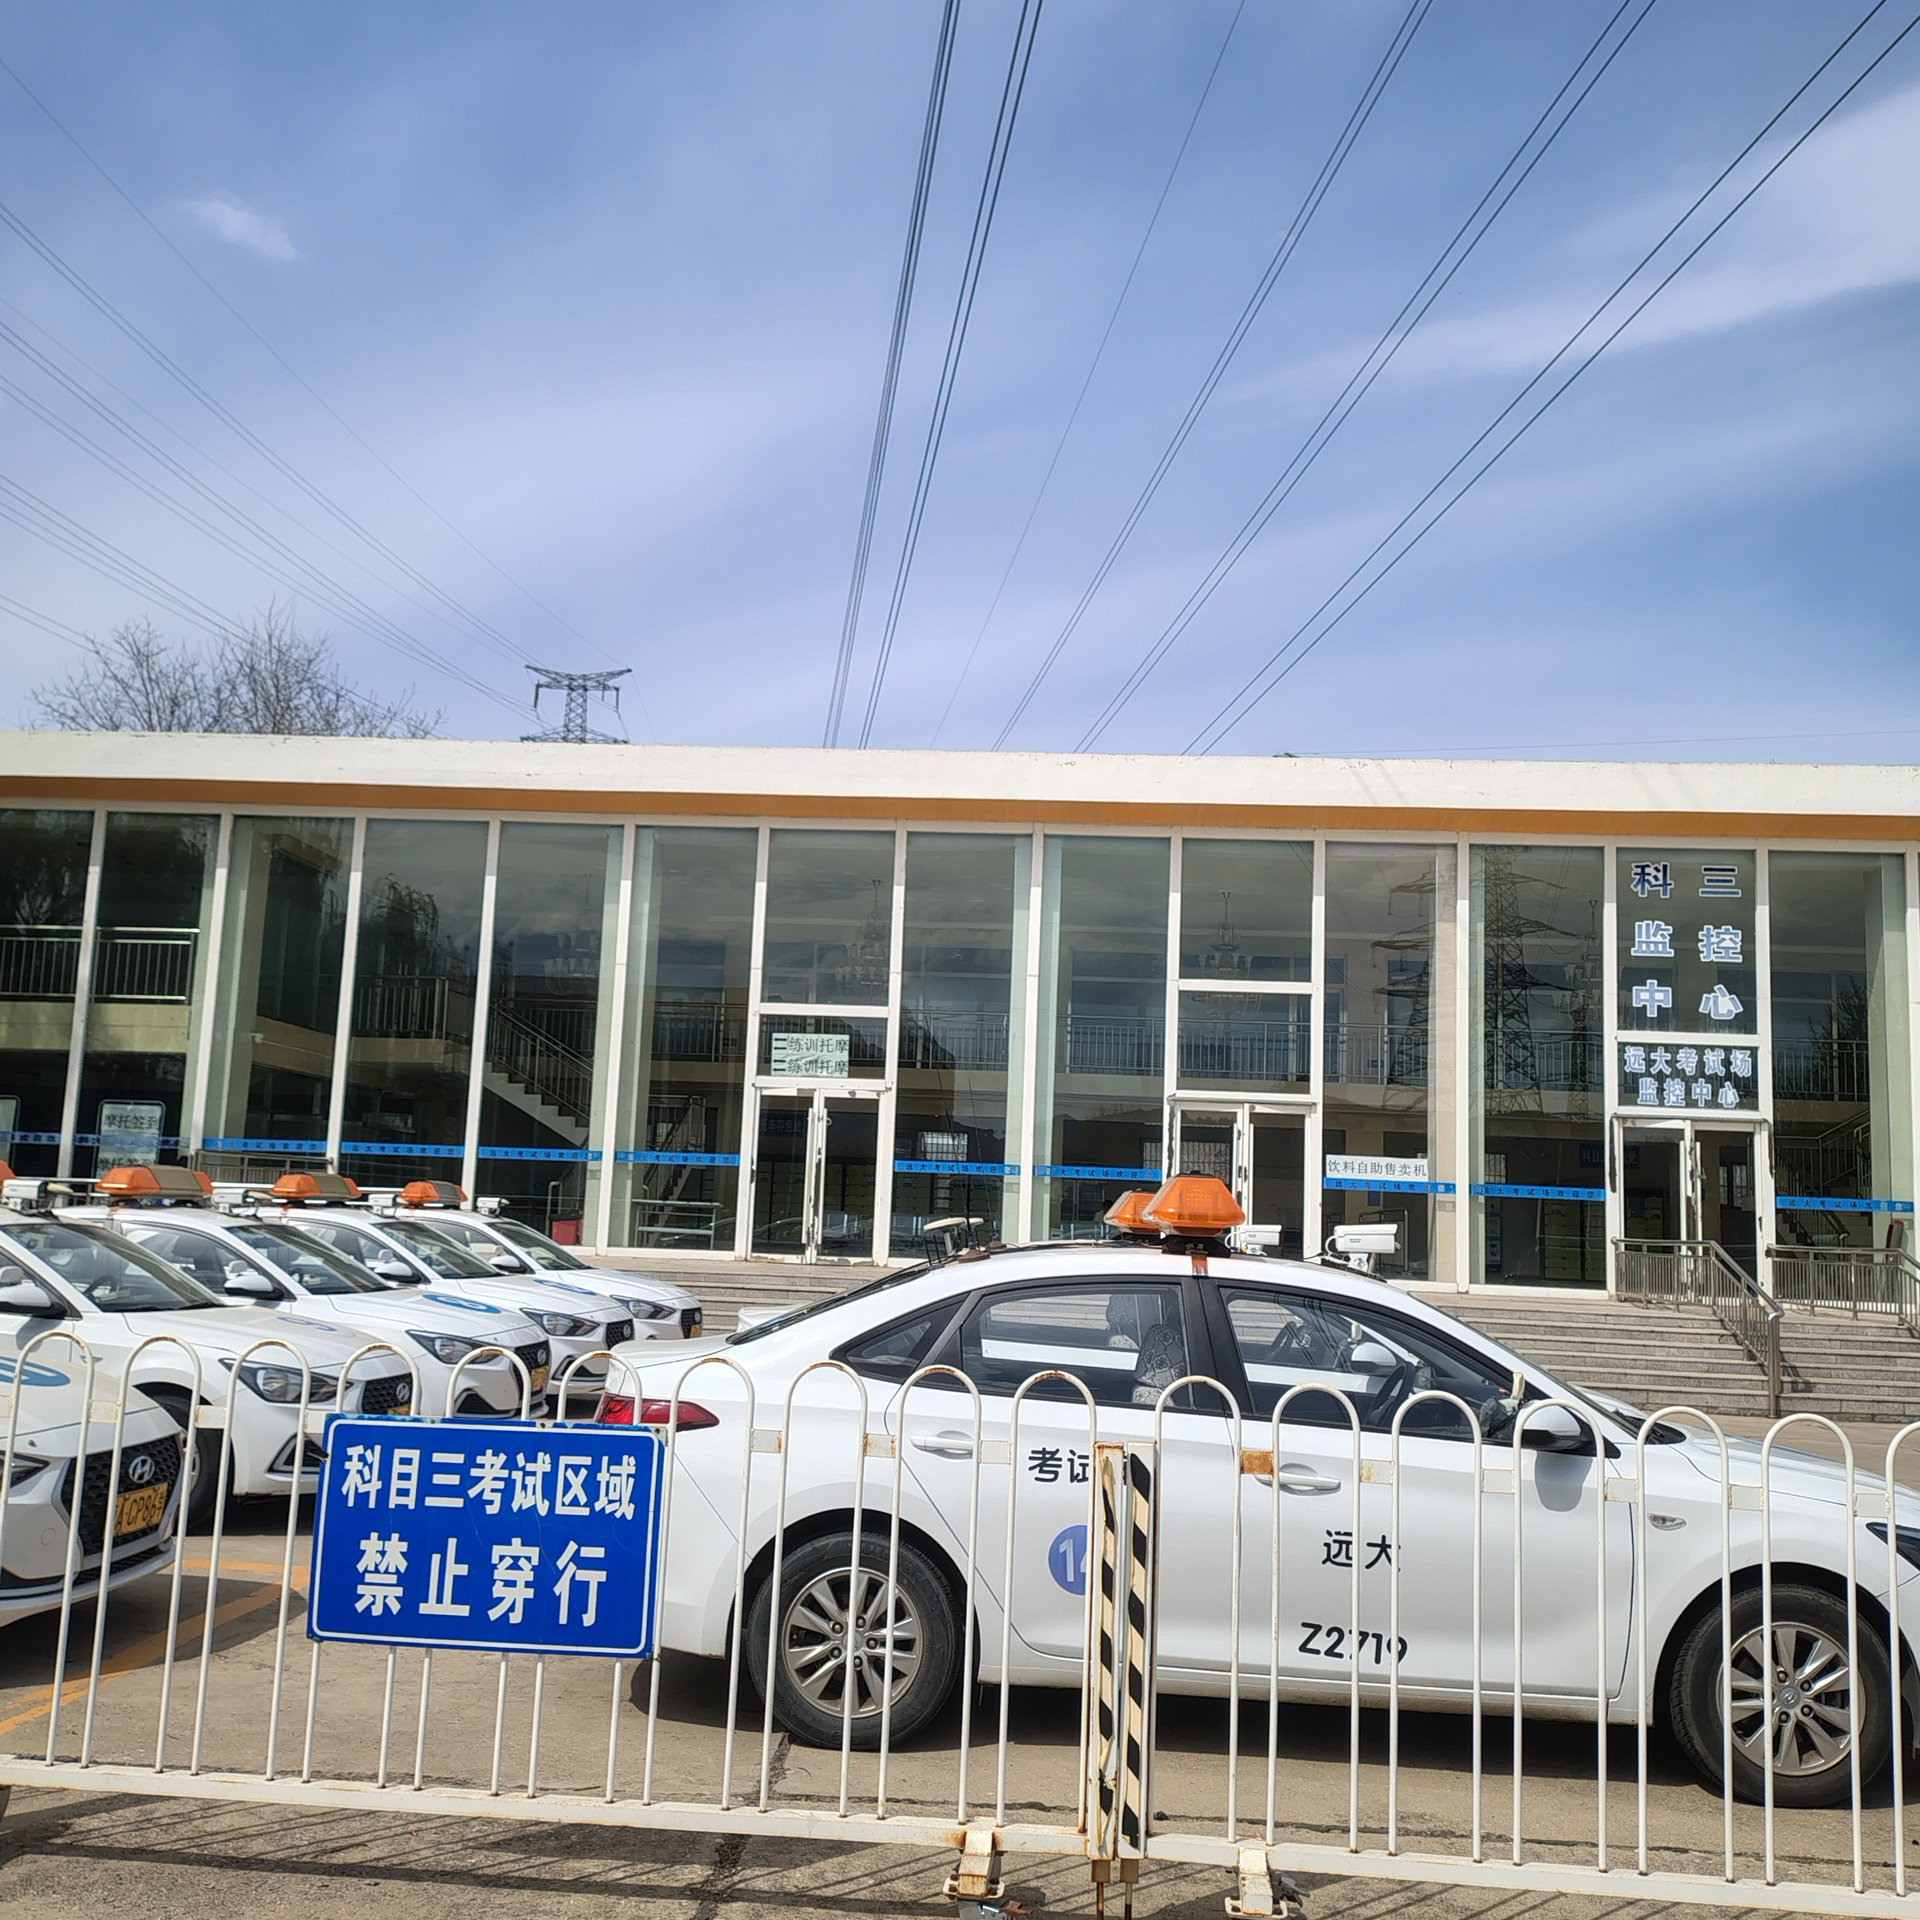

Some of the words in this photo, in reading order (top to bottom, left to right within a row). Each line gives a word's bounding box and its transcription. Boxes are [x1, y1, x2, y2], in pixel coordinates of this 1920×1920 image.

[1624, 1045, 1752, 1077] 远大考试场
[1637, 1077, 1740, 1107] 监控中心
[1328, 1159, 1427, 1177] 饮料自助售卖机
[341, 1444, 637, 1521] 科目三考试区域
[1028, 1447, 1127, 1486] 考试
[1321, 1529, 1401, 1573] 远大
[354, 1532, 607, 1627] 禁止穿行
